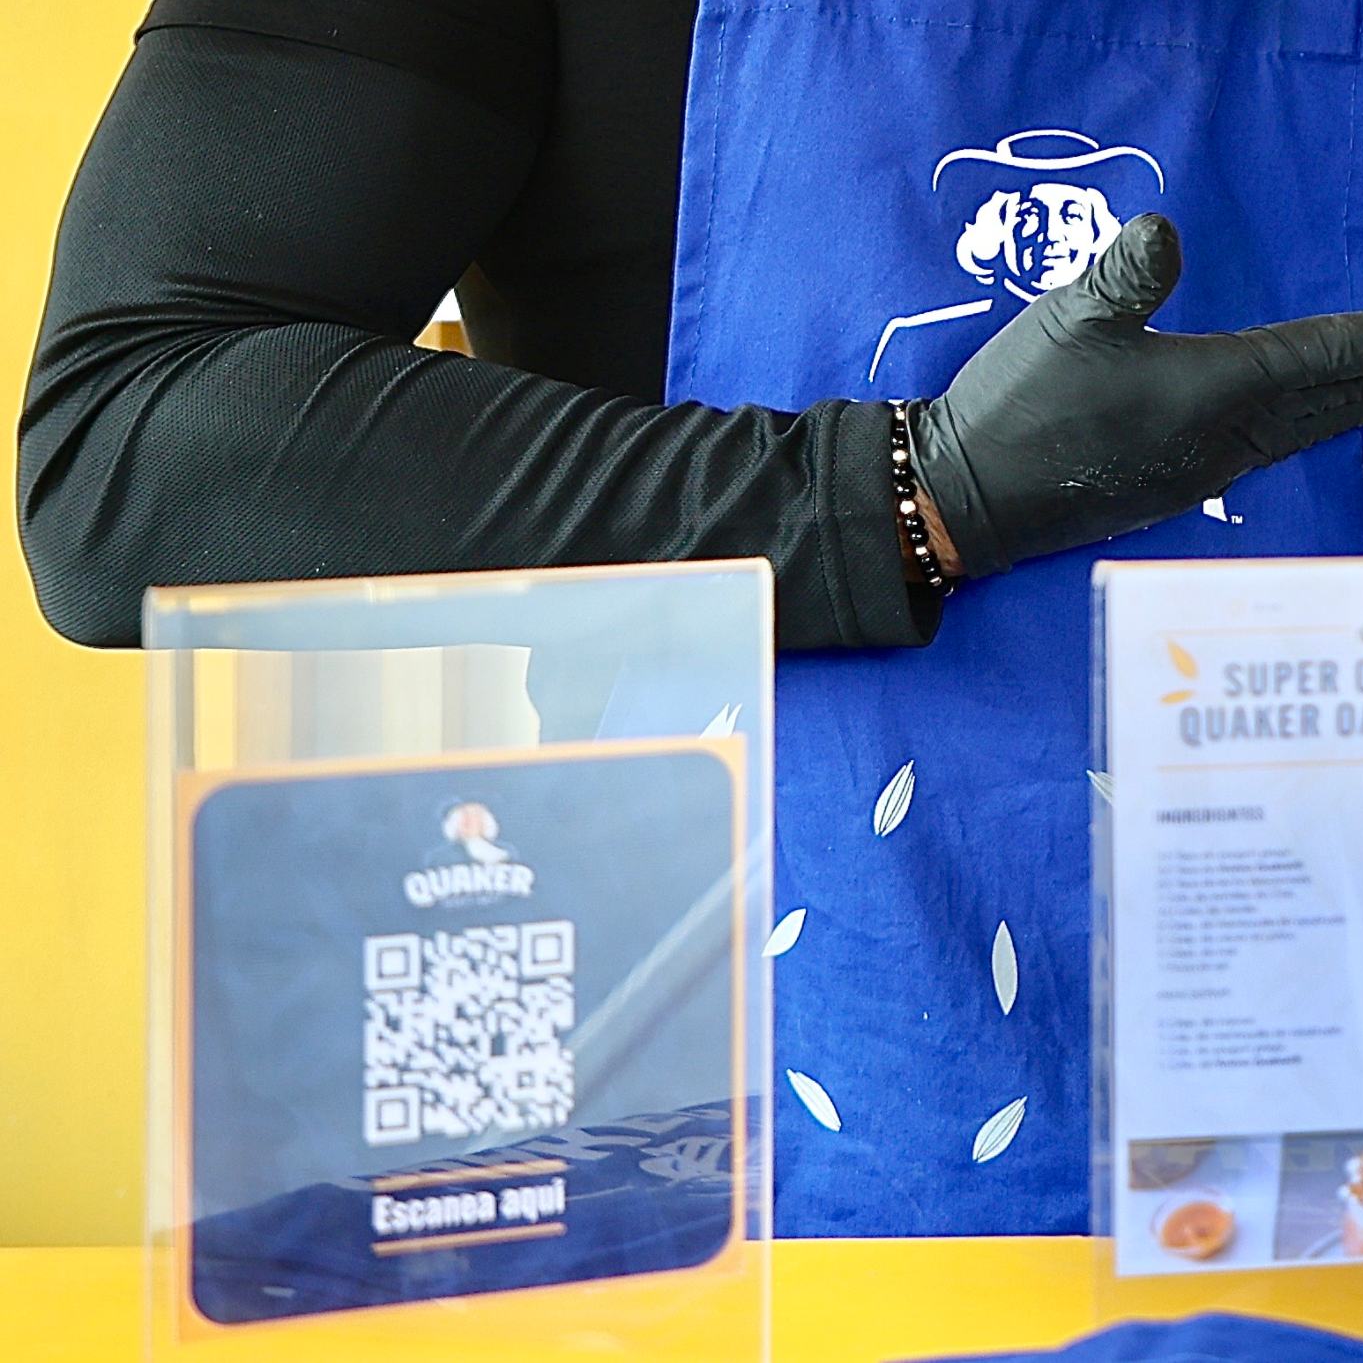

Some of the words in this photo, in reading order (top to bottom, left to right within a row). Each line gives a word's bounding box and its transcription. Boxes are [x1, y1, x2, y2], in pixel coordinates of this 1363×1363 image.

[1223, 660, 1339, 697] SUPER
[1179, 703, 1320, 747] QUAKER
[404, 863, 535, 907] QUAKER
[372, 1191, 497, 1235] Escanea
